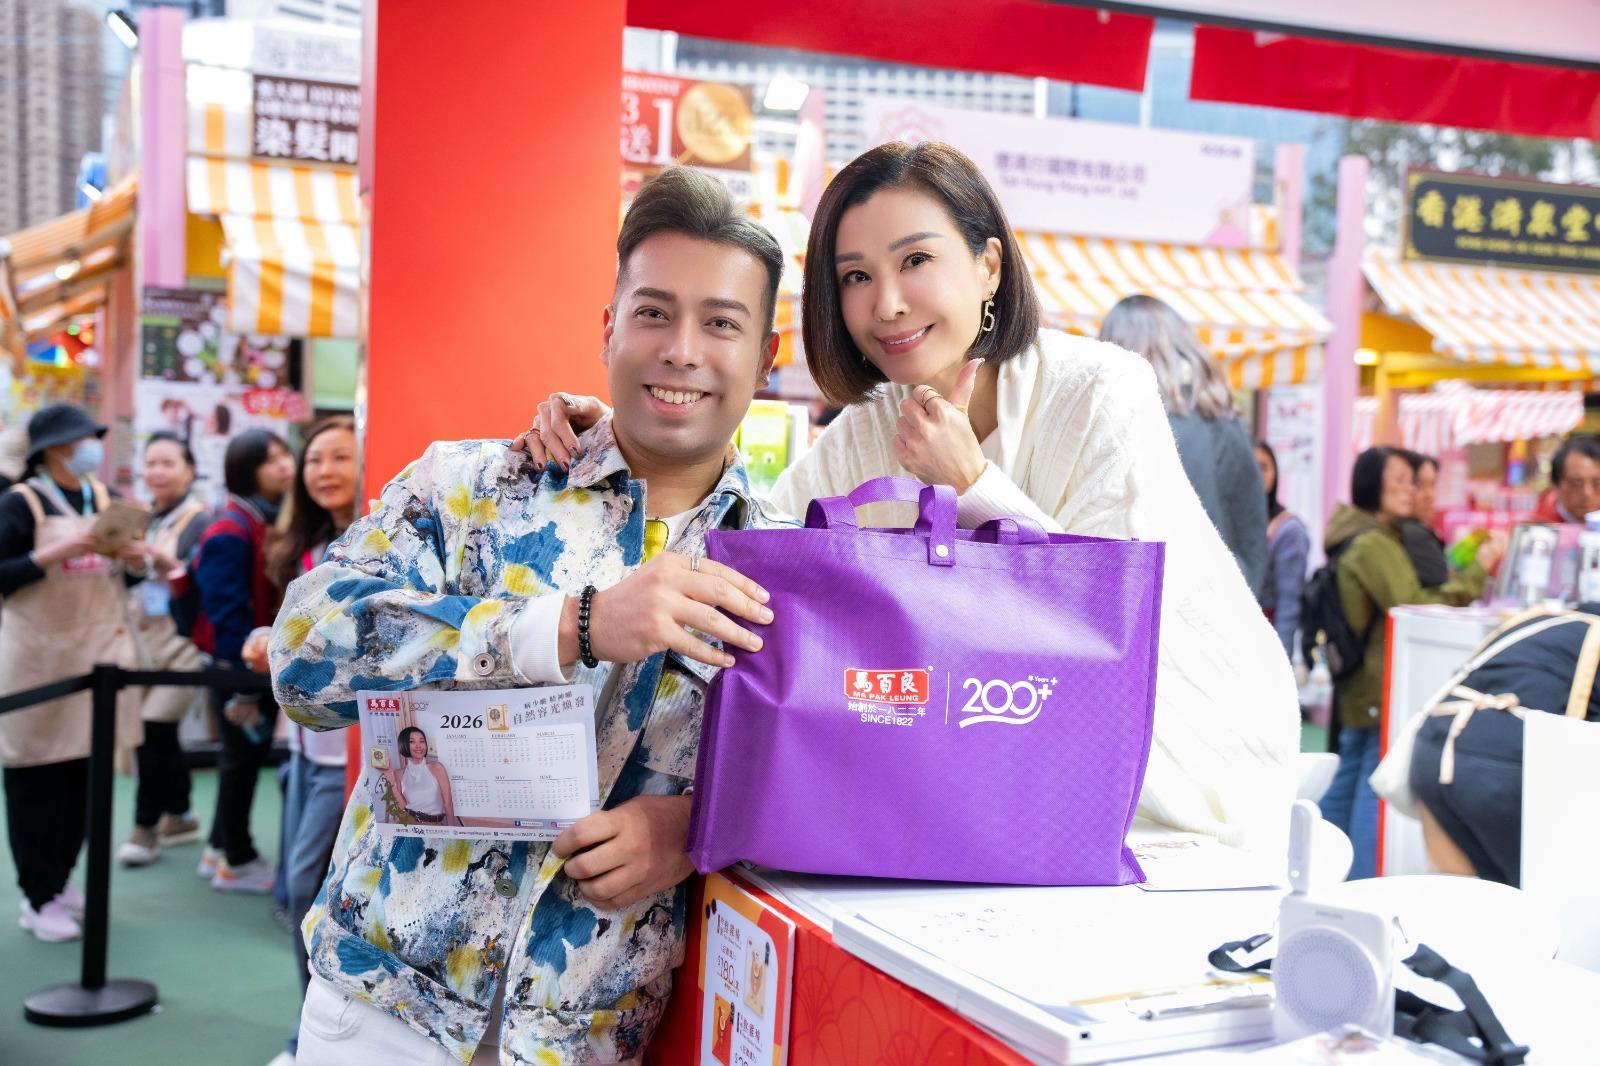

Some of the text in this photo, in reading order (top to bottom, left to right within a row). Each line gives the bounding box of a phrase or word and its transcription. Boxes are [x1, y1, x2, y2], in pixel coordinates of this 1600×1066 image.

[853, 671, 919, 694] 馬百良
[852, 691, 919, 702] MA PAK LEUNG
[513, 695, 585, 725] 自然容光煥發
[847, 701, 926, 717] 始創於一八二二年
[440, 714, 483, 729] 2026
[860, 713, 913, 727] SINCE1822
